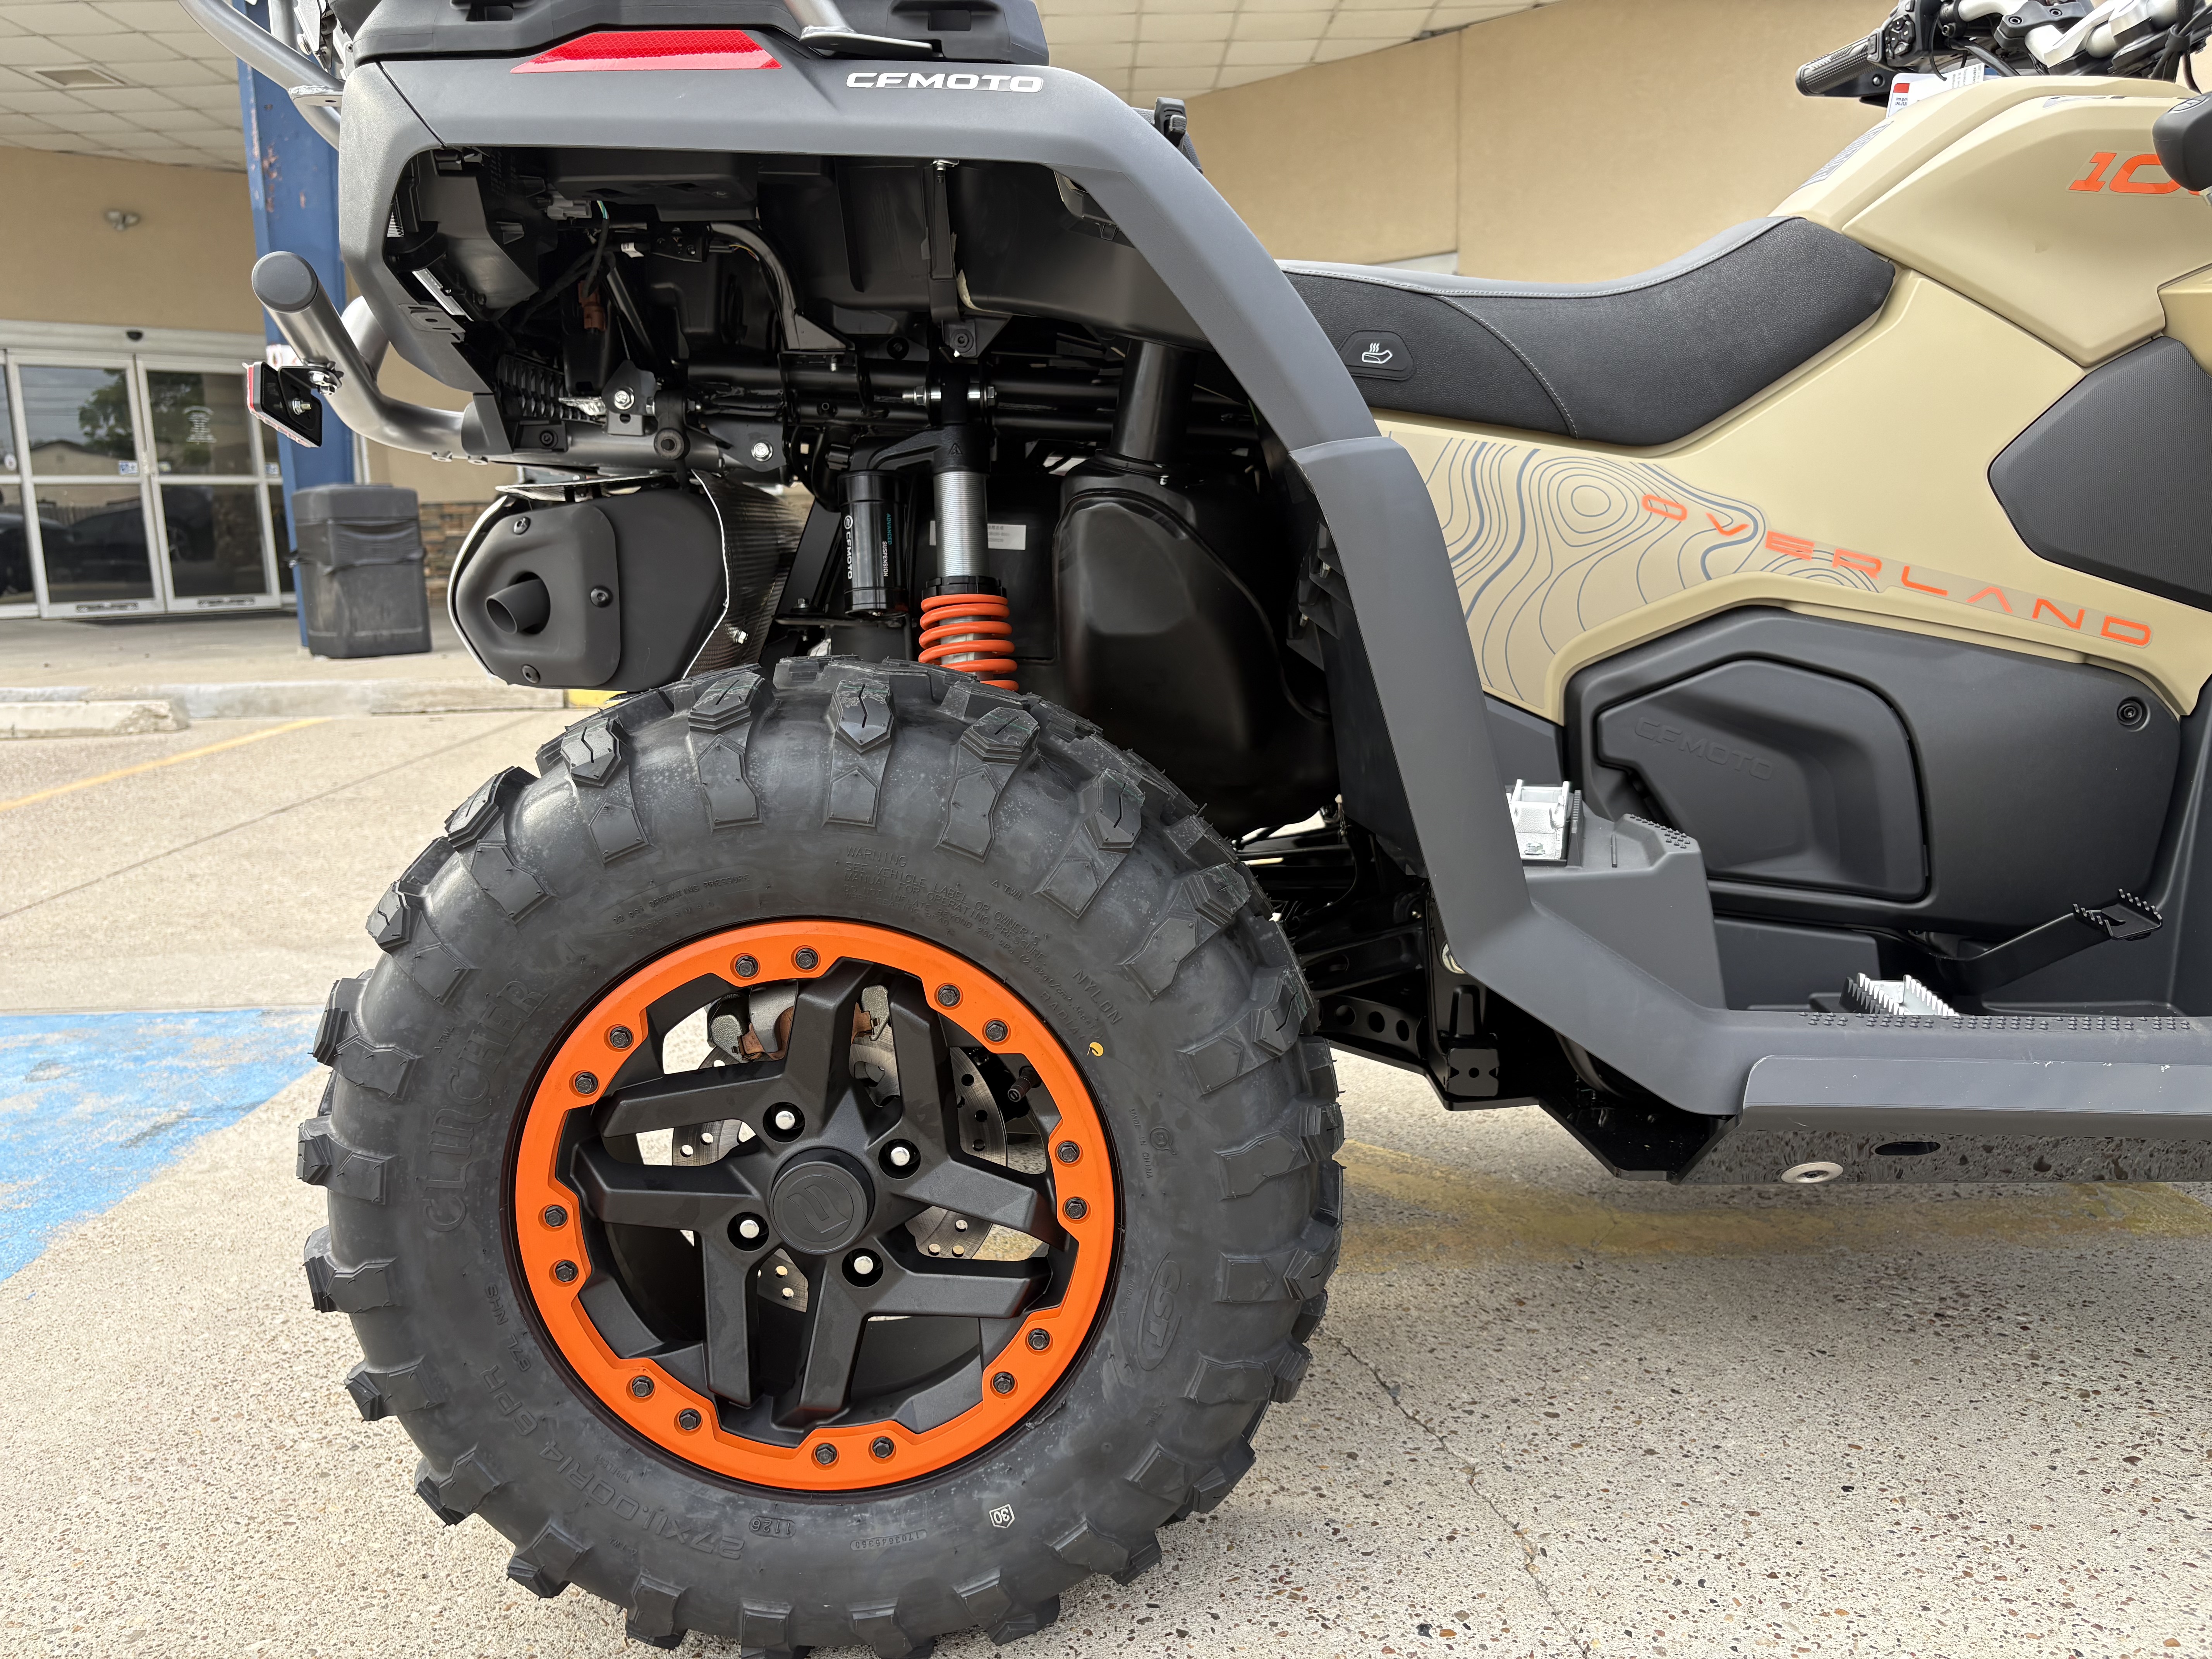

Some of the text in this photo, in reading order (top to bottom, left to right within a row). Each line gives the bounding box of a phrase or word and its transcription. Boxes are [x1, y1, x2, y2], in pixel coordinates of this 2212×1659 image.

[846, 72, 1043, 93] CFMOTO
[2068, 151, 2200, 196] 10
[1641, 495, 2152, 647] OVERLAND
[1635, 717, 1772, 780] CFMOTO
[847, 846, 907, 867] WARNING
[613, 915, 625, 925] 22
[649, 884, 700, 908] OPERATING
[703, 874, 750, 888] PRESSURE
[845, 862, 867, 873] SEE
[877, 866, 927, 888] VEHICLE
[933, 882, 967, 903] LABEL
[975, 900, 990, 911] OR
[845, 872, 888, 887] MANUAL
[898, 882, 920, 895] FOR
[927, 892, 989, 925] OPERATING
[1040, 991, 1085, 1044] RADIAL
[1072, 969, 1122, 1025] NYLON
[423, 981, 549, 1232] CLINCHER
[1129, 1108, 1153, 1178] MADE IN CHINA
[485, 1283, 508, 1326] NHS
[1147, 1260, 1181, 1348] CST
[480, 1364, 538, 1436] 6PR
[752, 1518, 791, 1535] 1126
[993, 1508, 1010, 1524] 30
